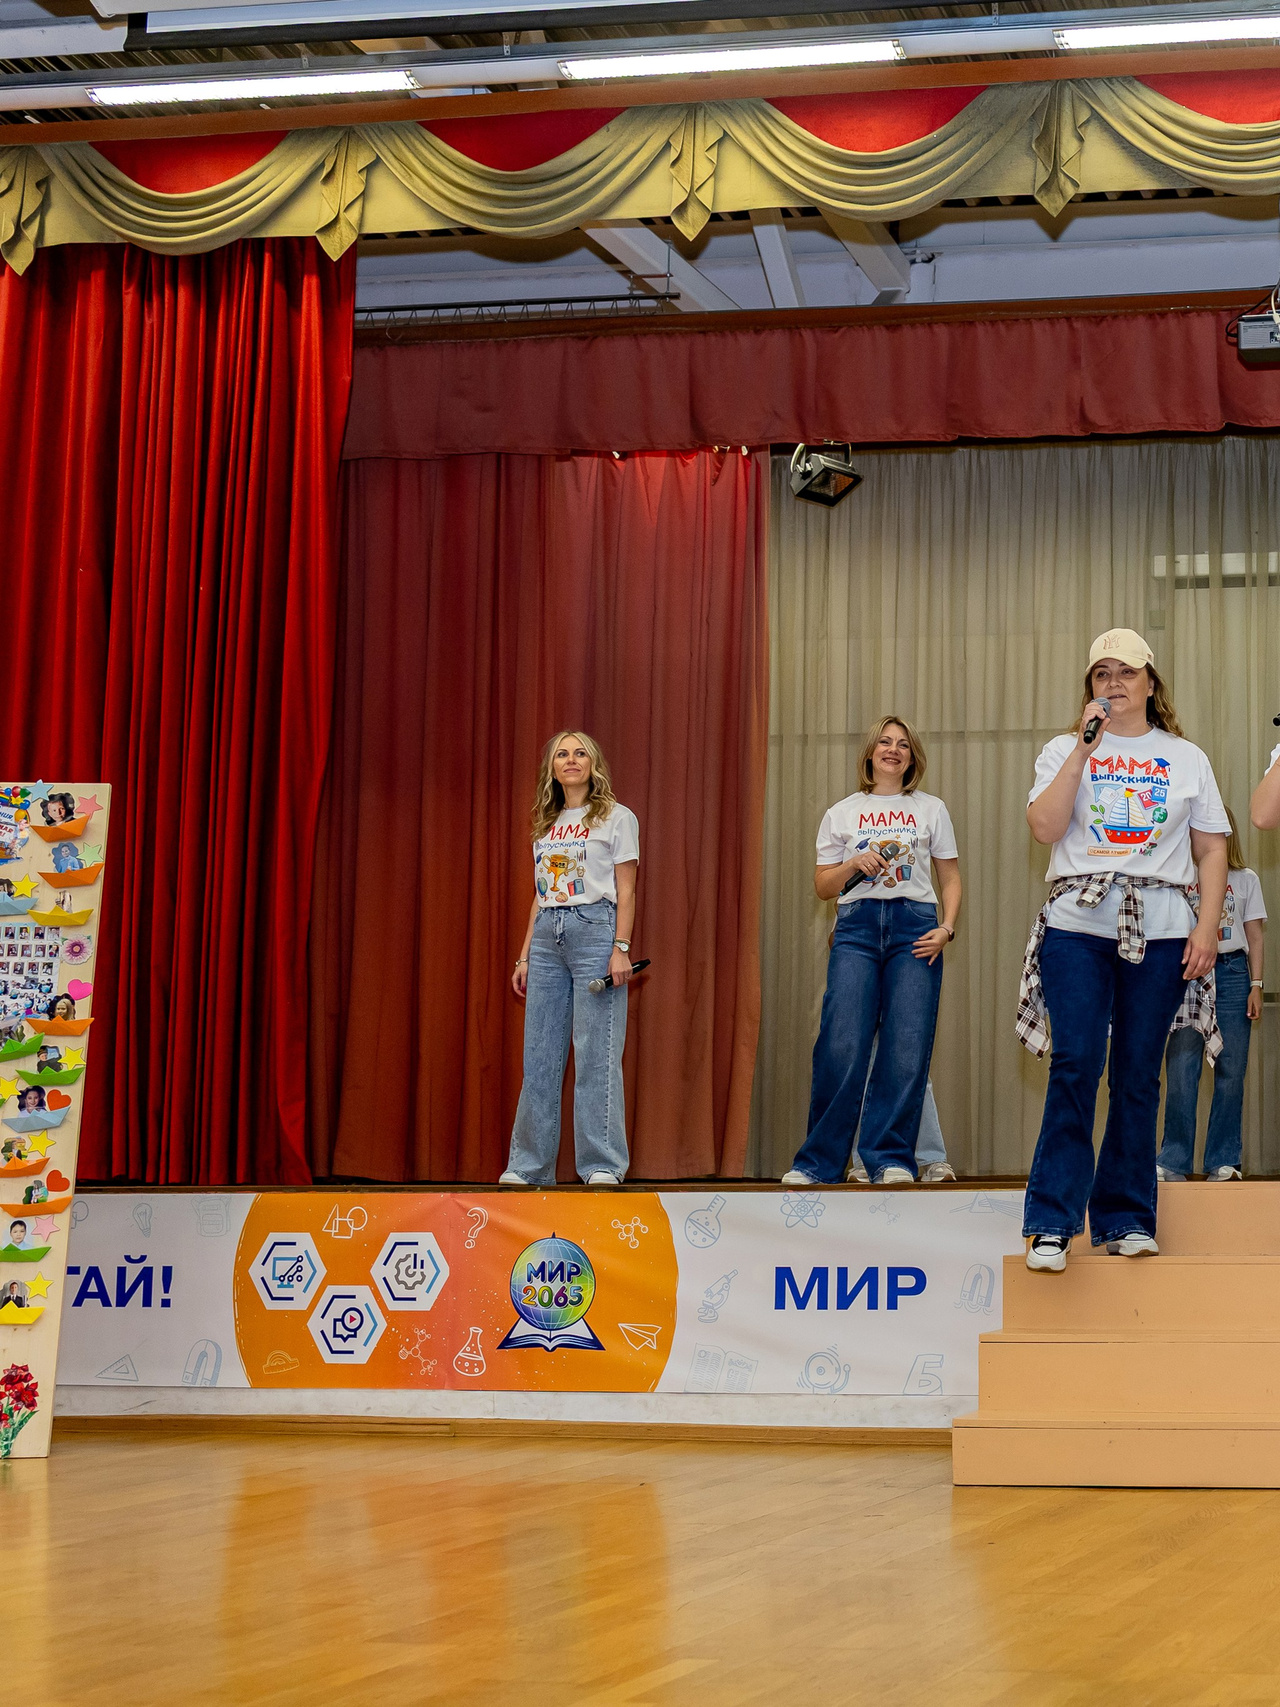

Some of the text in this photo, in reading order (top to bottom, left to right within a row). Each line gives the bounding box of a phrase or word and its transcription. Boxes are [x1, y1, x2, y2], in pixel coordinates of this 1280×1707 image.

[1089, 755, 1169, 778] МАМА
[1154, 786, 1166, 797] 25
[859, 811, 917, 829] МАМА
[857, 827, 917, 837] выпускника
[527, 1260, 583, 1284] МИР
[522, 1285, 584, 1308] 2065
[774, 1266, 927, 1310] МИР
